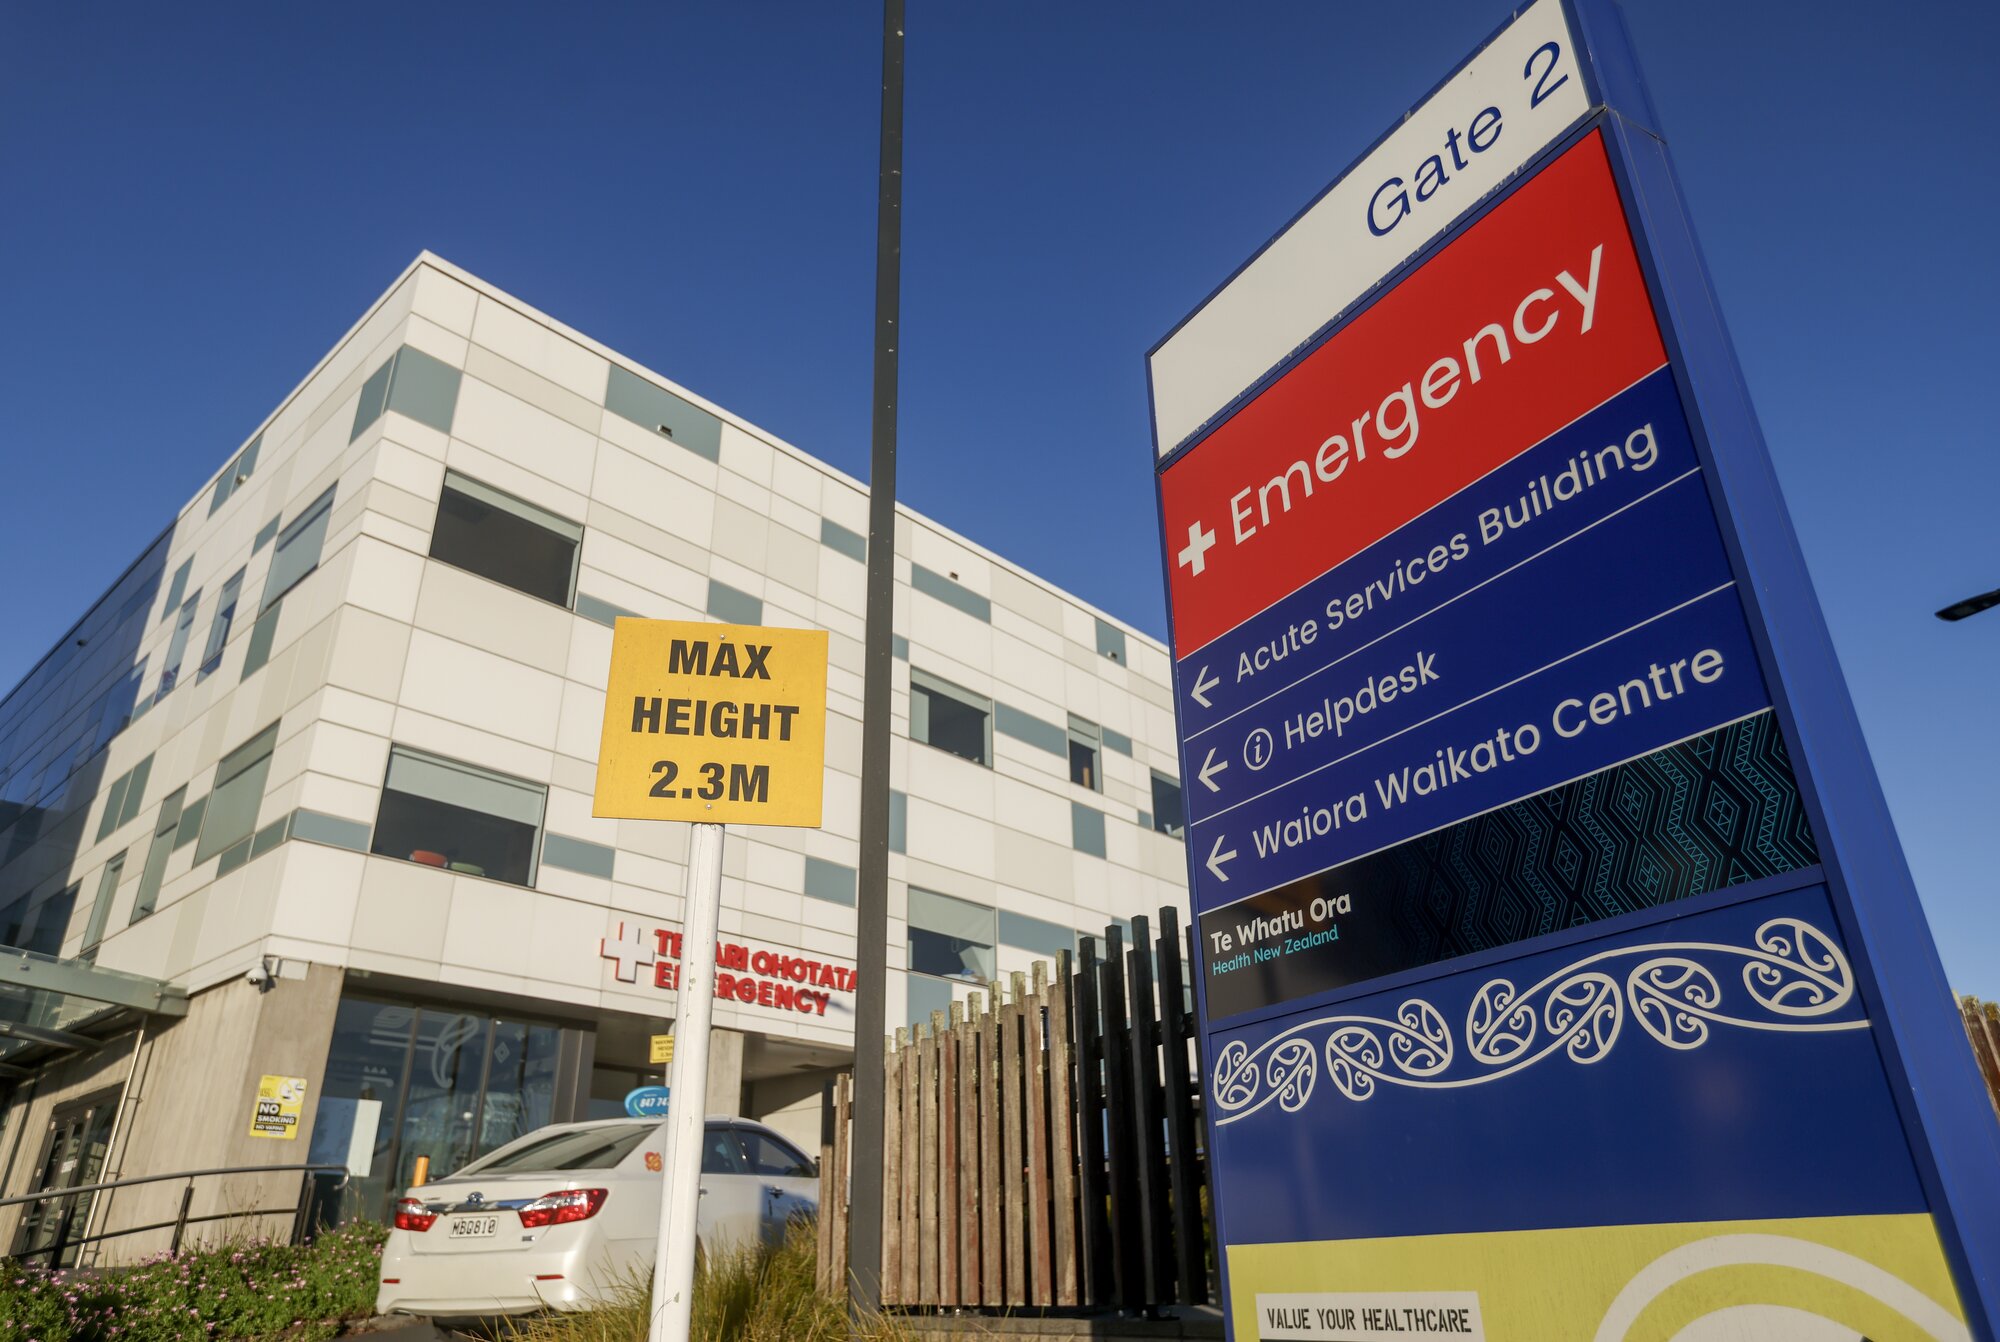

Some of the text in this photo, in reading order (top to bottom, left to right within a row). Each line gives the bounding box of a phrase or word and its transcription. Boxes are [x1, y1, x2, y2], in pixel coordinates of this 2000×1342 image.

[1366, 40, 1569, 237] Gate 2
[1231, 243, 1604, 546] Emergency
[1236, 422, 1659, 683] Acute Services Building
[668, 639, 773, 680] MAX
[631, 696, 799, 741] HEIGHT
[1284, 649, 1440, 750] Helpdesk
[1252, 647, 1725, 859] Waiora Waikato Centre
[649, 760, 770, 802] 2.3M
[1210, 893, 1352, 954] Te Whatu Ora
[1212, 924, 1339, 976] Health New Zealand
[654, 961, 830, 1017] ERGENCY
[257, 1115, 295, 1124] SMOKING
[259, 1103, 279, 1114] NO
[452, 1219, 496, 1235] MBQ810
[1267, 1308, 1472, 1333] VALUE YOUR HEALTHCARE
